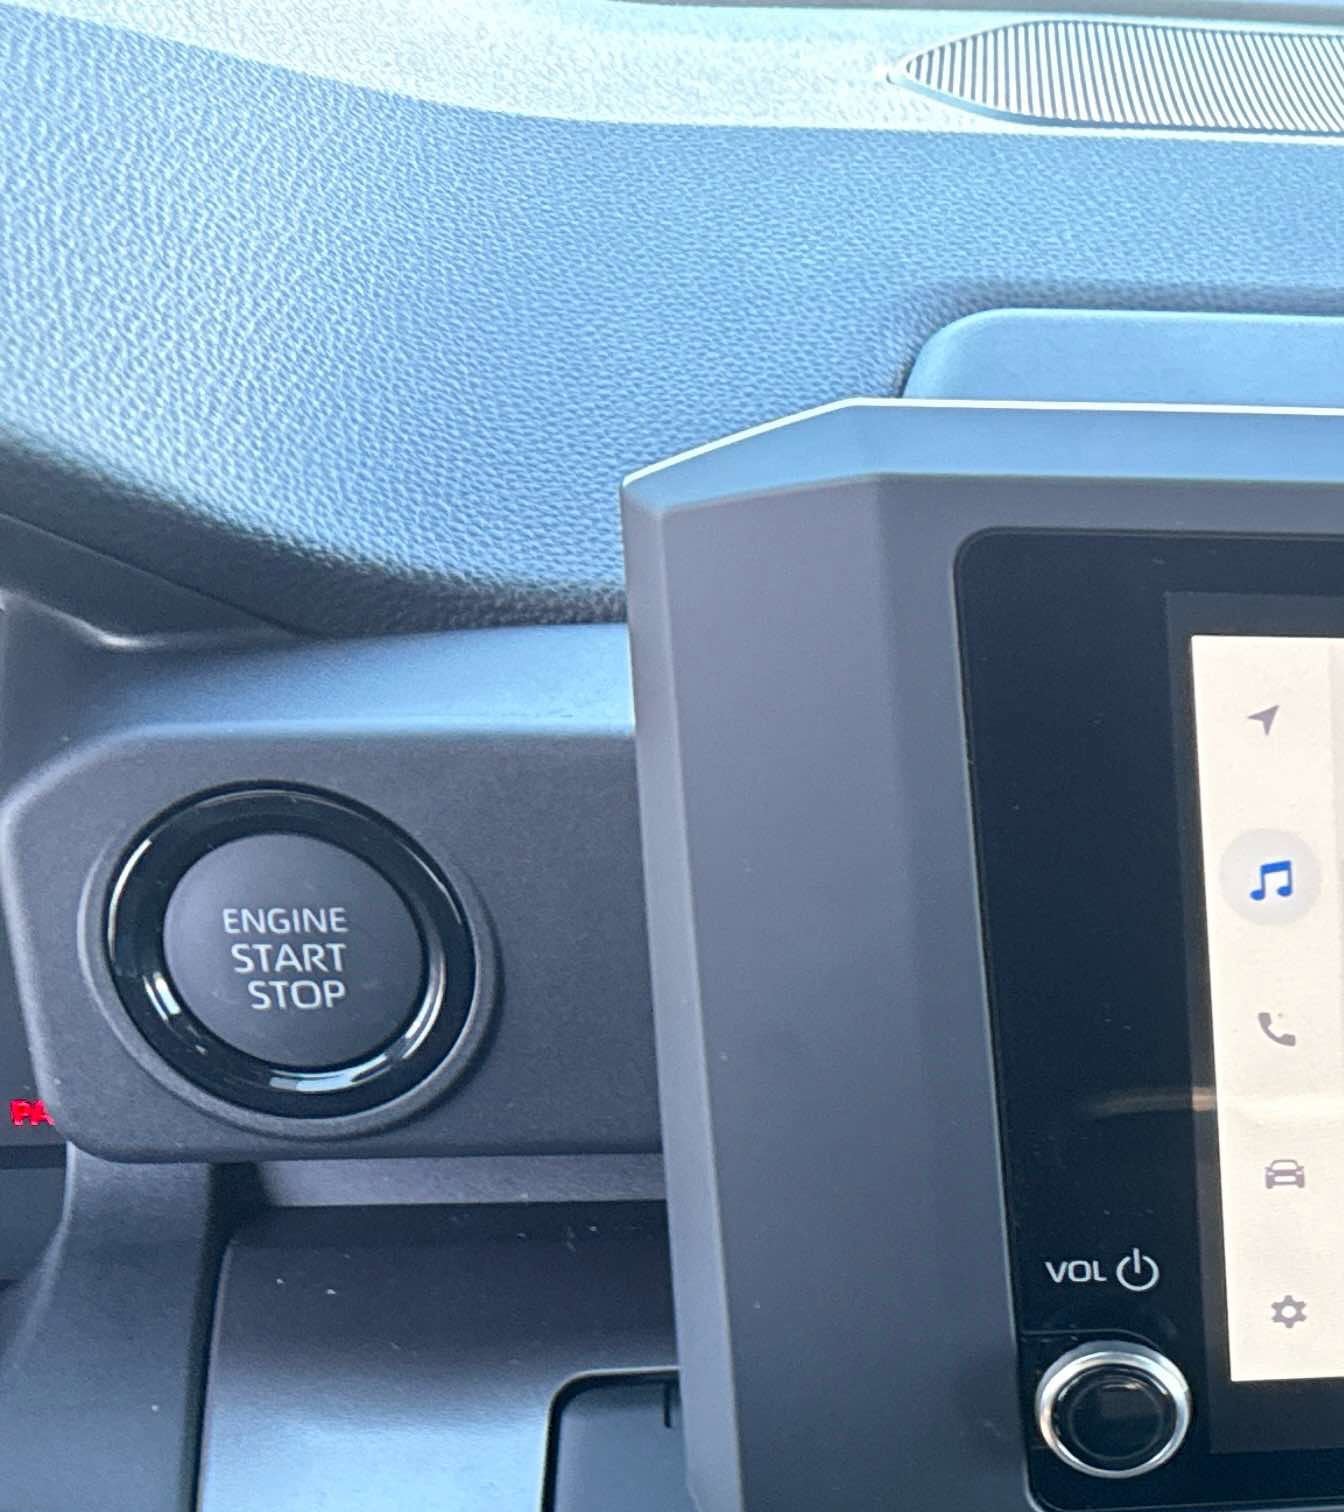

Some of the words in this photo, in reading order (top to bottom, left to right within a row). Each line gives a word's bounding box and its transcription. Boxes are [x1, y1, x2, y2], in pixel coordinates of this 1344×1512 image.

[222, 907, 348, 935] ENGINE
[230, 943, 347, 973] START
[247, 980, 346, 1010] STOP
[1045, 1260, 1107, 1283] VOL
